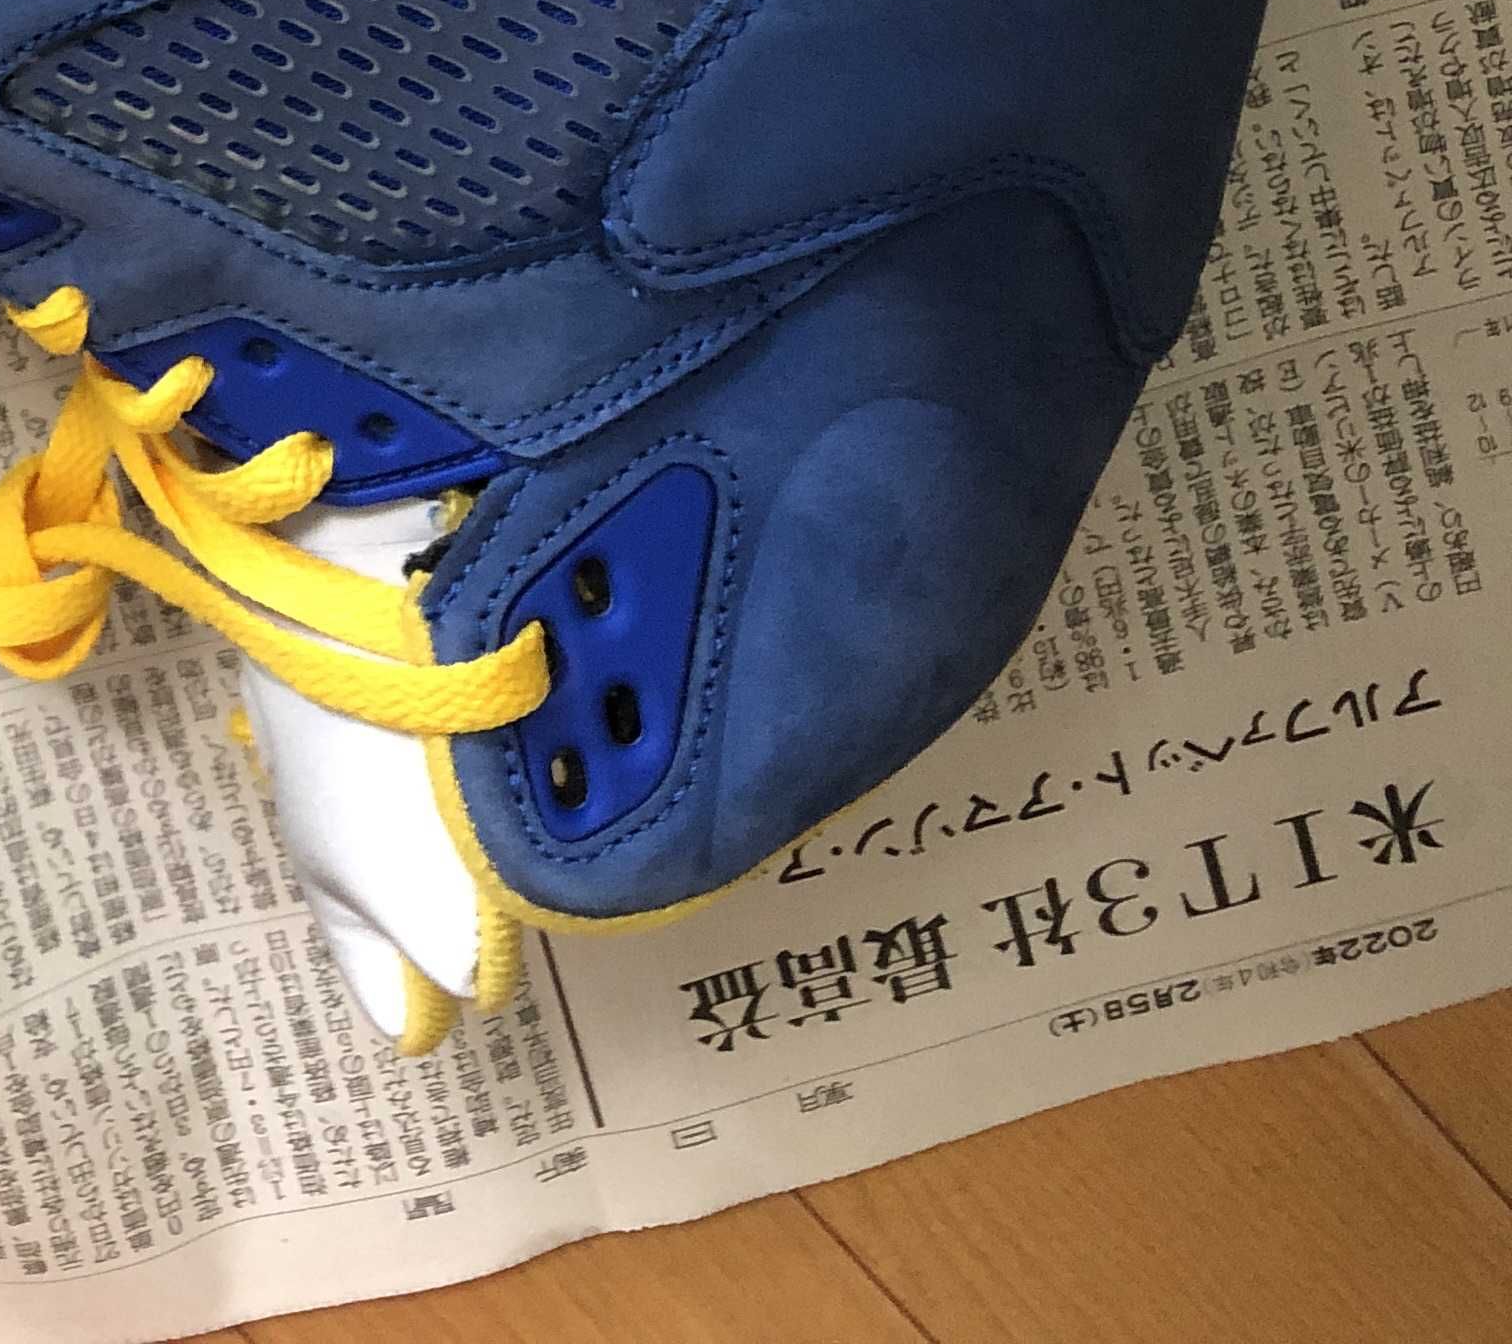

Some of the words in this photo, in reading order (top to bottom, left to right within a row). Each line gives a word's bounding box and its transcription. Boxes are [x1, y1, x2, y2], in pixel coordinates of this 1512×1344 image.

[1355, 225, 1408, 313] 話した。
[976, 769, 1454, 976] 米IT3社
[673, 905, 964, 1061] 最高益
